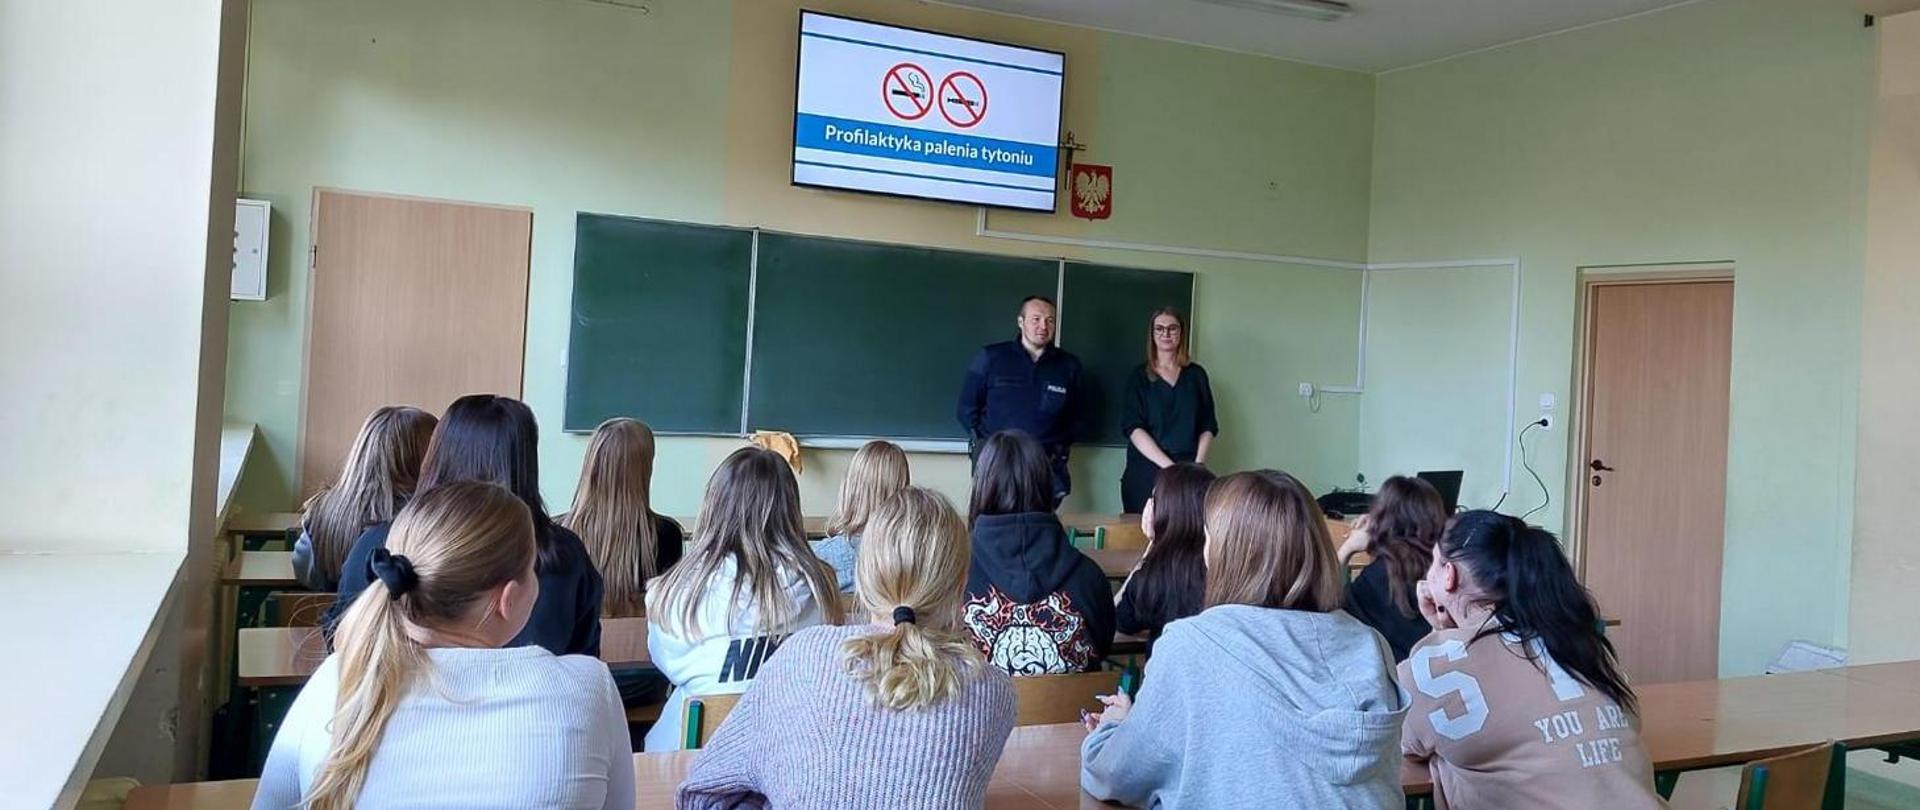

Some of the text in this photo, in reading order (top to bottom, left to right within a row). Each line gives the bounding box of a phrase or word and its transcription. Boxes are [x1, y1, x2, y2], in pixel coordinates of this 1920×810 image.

[825, 124, 1034, 166] Profilaktyka palenia tytoniu
[1534, 710, 1583, 743] YOU
[1576, 738, 1622, 768] LIFE
